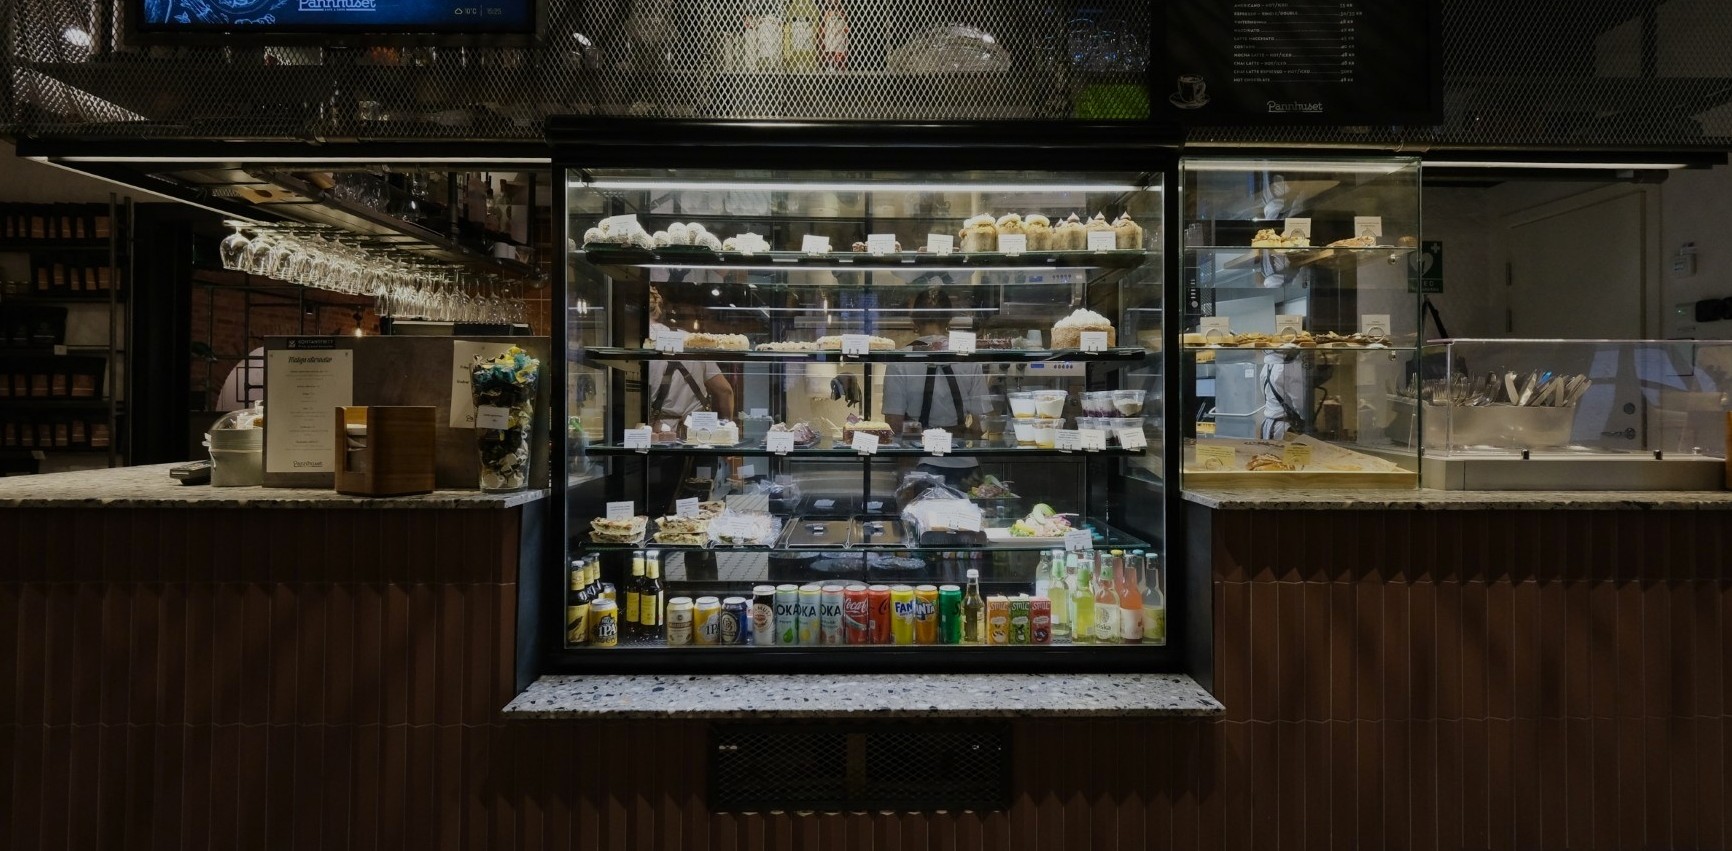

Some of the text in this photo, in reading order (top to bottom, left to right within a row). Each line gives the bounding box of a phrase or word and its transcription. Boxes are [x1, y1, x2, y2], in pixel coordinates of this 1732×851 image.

[298, 0, 377, 10] Pannhuset
[1266, 100, 1324, 112] Pannhuset
[777, 603, 798, 616] OKA
[821, 604, 842, 617] OKA
[895, 599, 913, 613] FAN
[915, 602, 936, 614] ANTA
[598, 623, 617, 637] IPA
